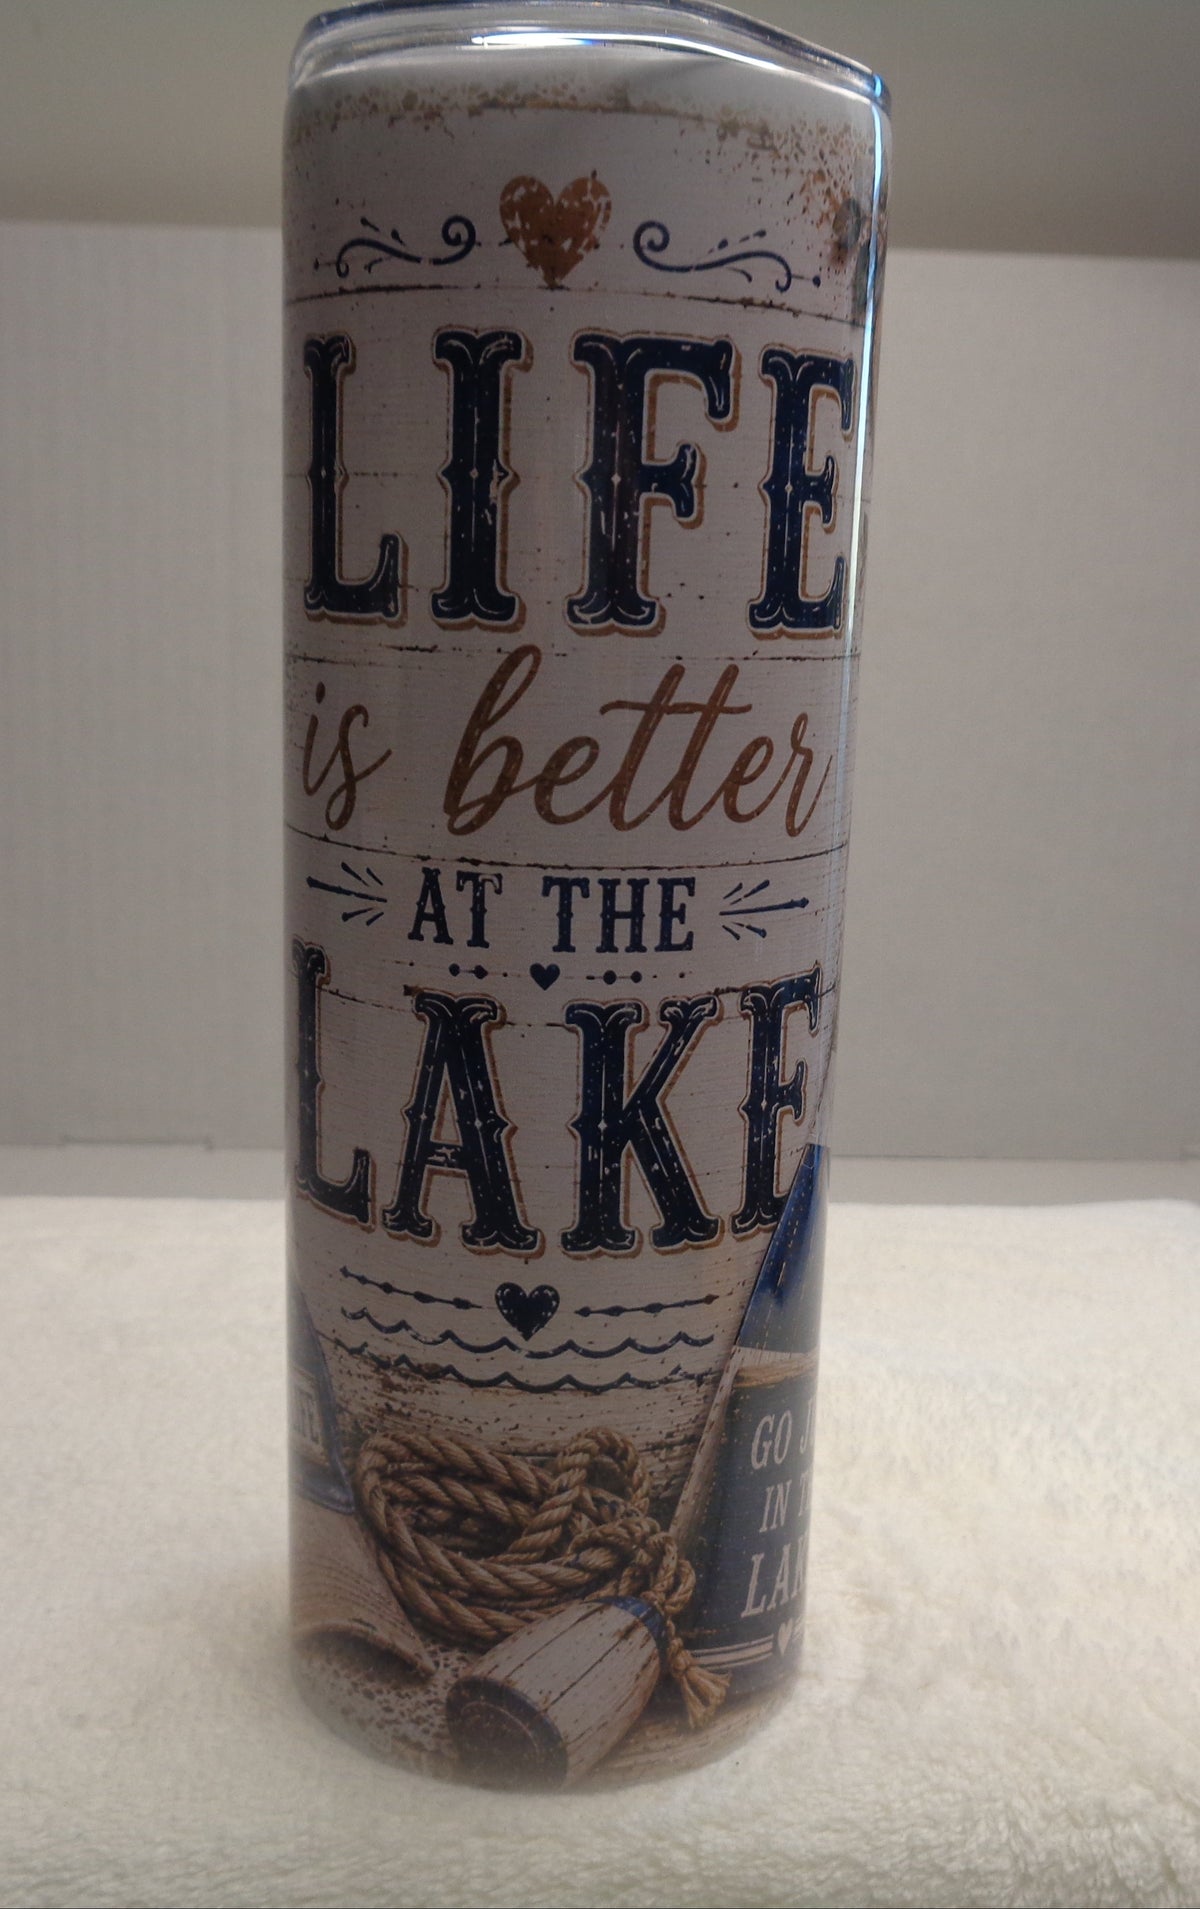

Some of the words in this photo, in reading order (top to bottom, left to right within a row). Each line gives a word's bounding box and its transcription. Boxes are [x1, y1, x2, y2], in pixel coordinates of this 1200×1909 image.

[303, 325, 855, 640] LIFE
[302, 682, 392, 832] is
[442, 643, 833, 838] better
[407, 867, 503, 949] AT
[541, 875, 697, 954] THE
[293, 939, 822, 1257] LAKE
[750, 1410, 793, 1470] GO
[758, 1479, 793, 1534] IN
